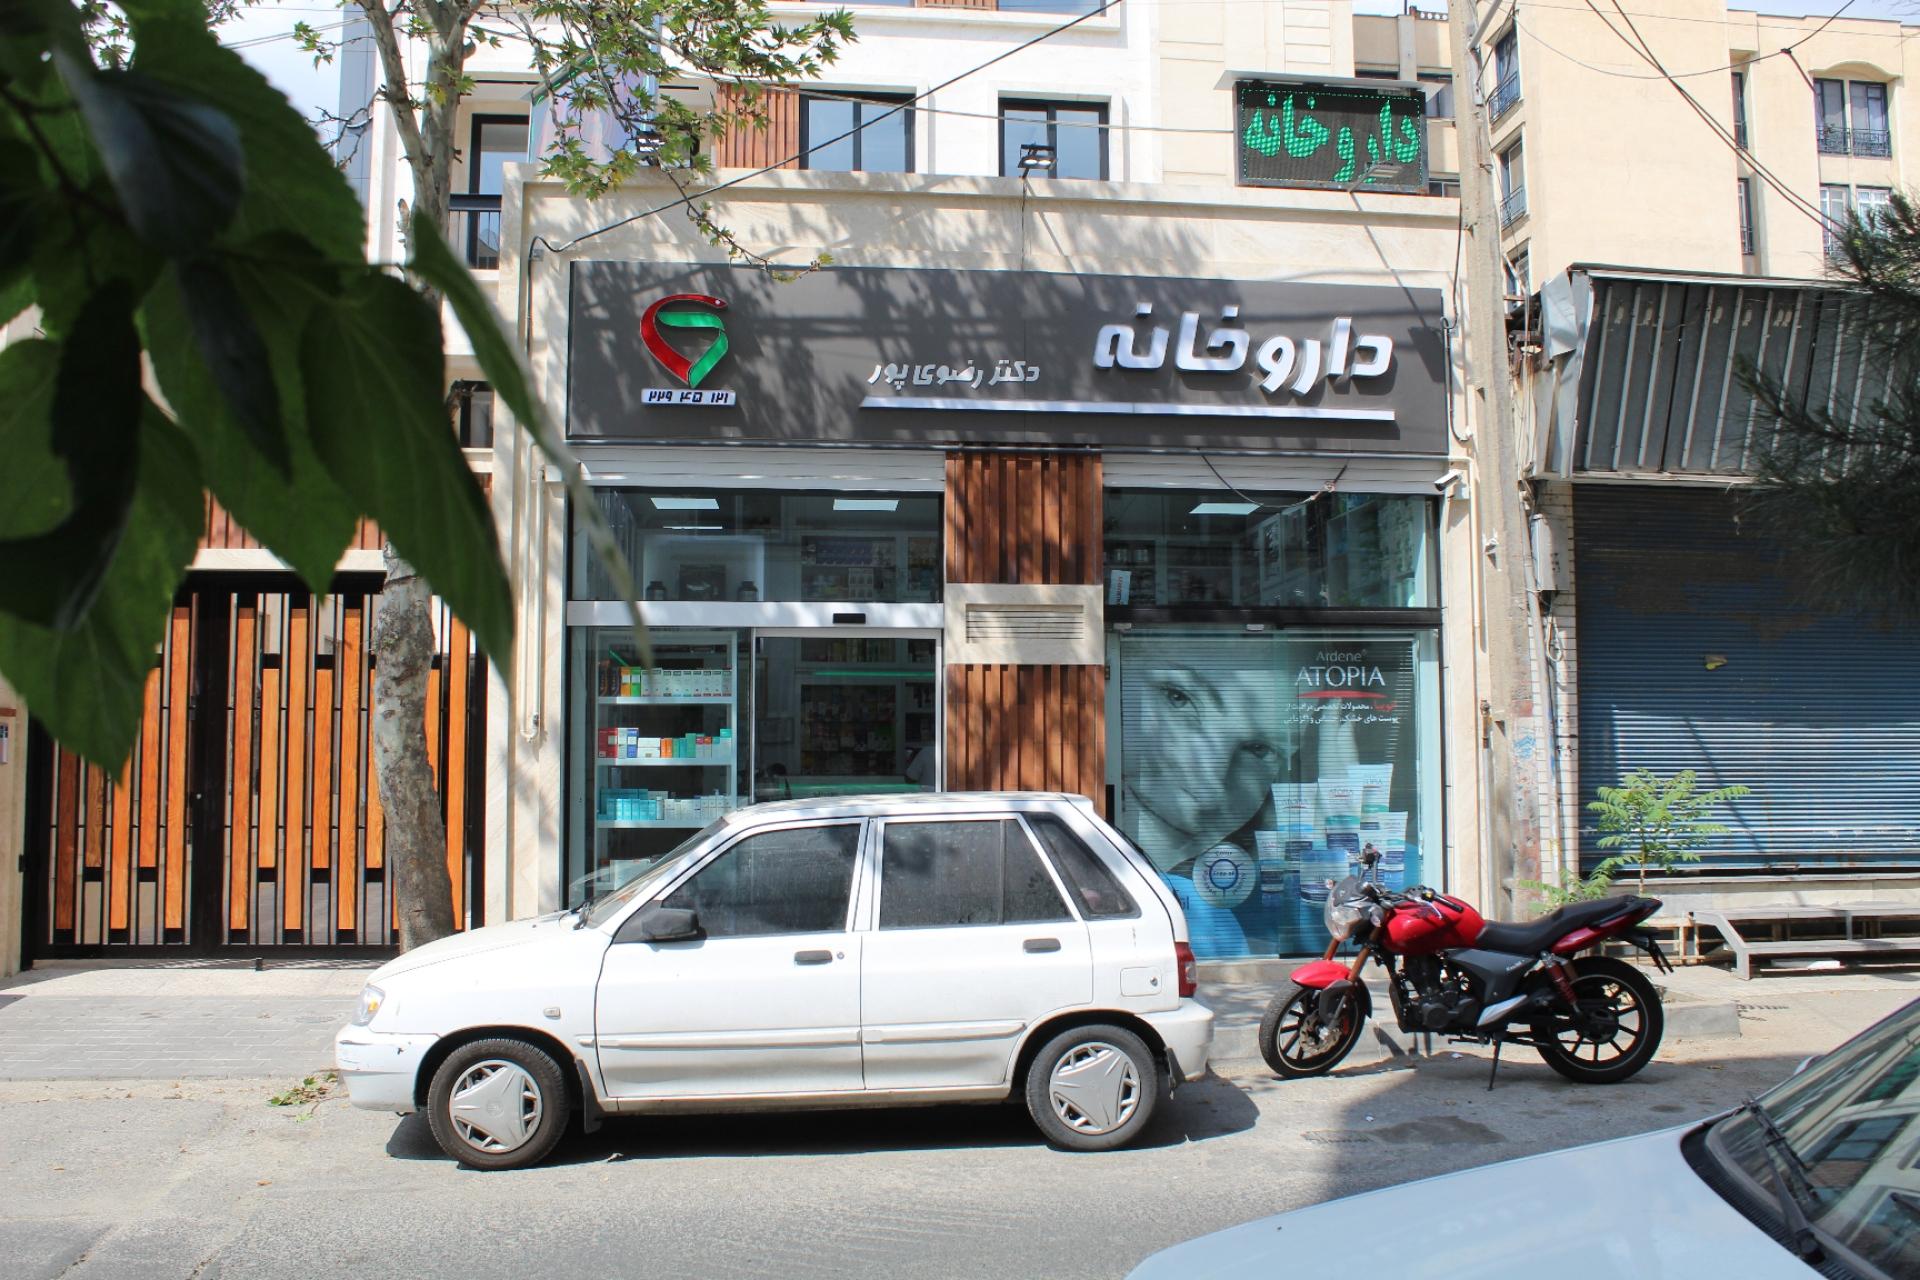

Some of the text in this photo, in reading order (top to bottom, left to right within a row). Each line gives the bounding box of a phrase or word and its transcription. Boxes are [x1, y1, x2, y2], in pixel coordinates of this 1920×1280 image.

[1093, 302, 1394, 396] داروخانه
[867, 359, 1041, 391] دکتر رضوی پور
[1294, 666, 1386, 686] ATOPIA
